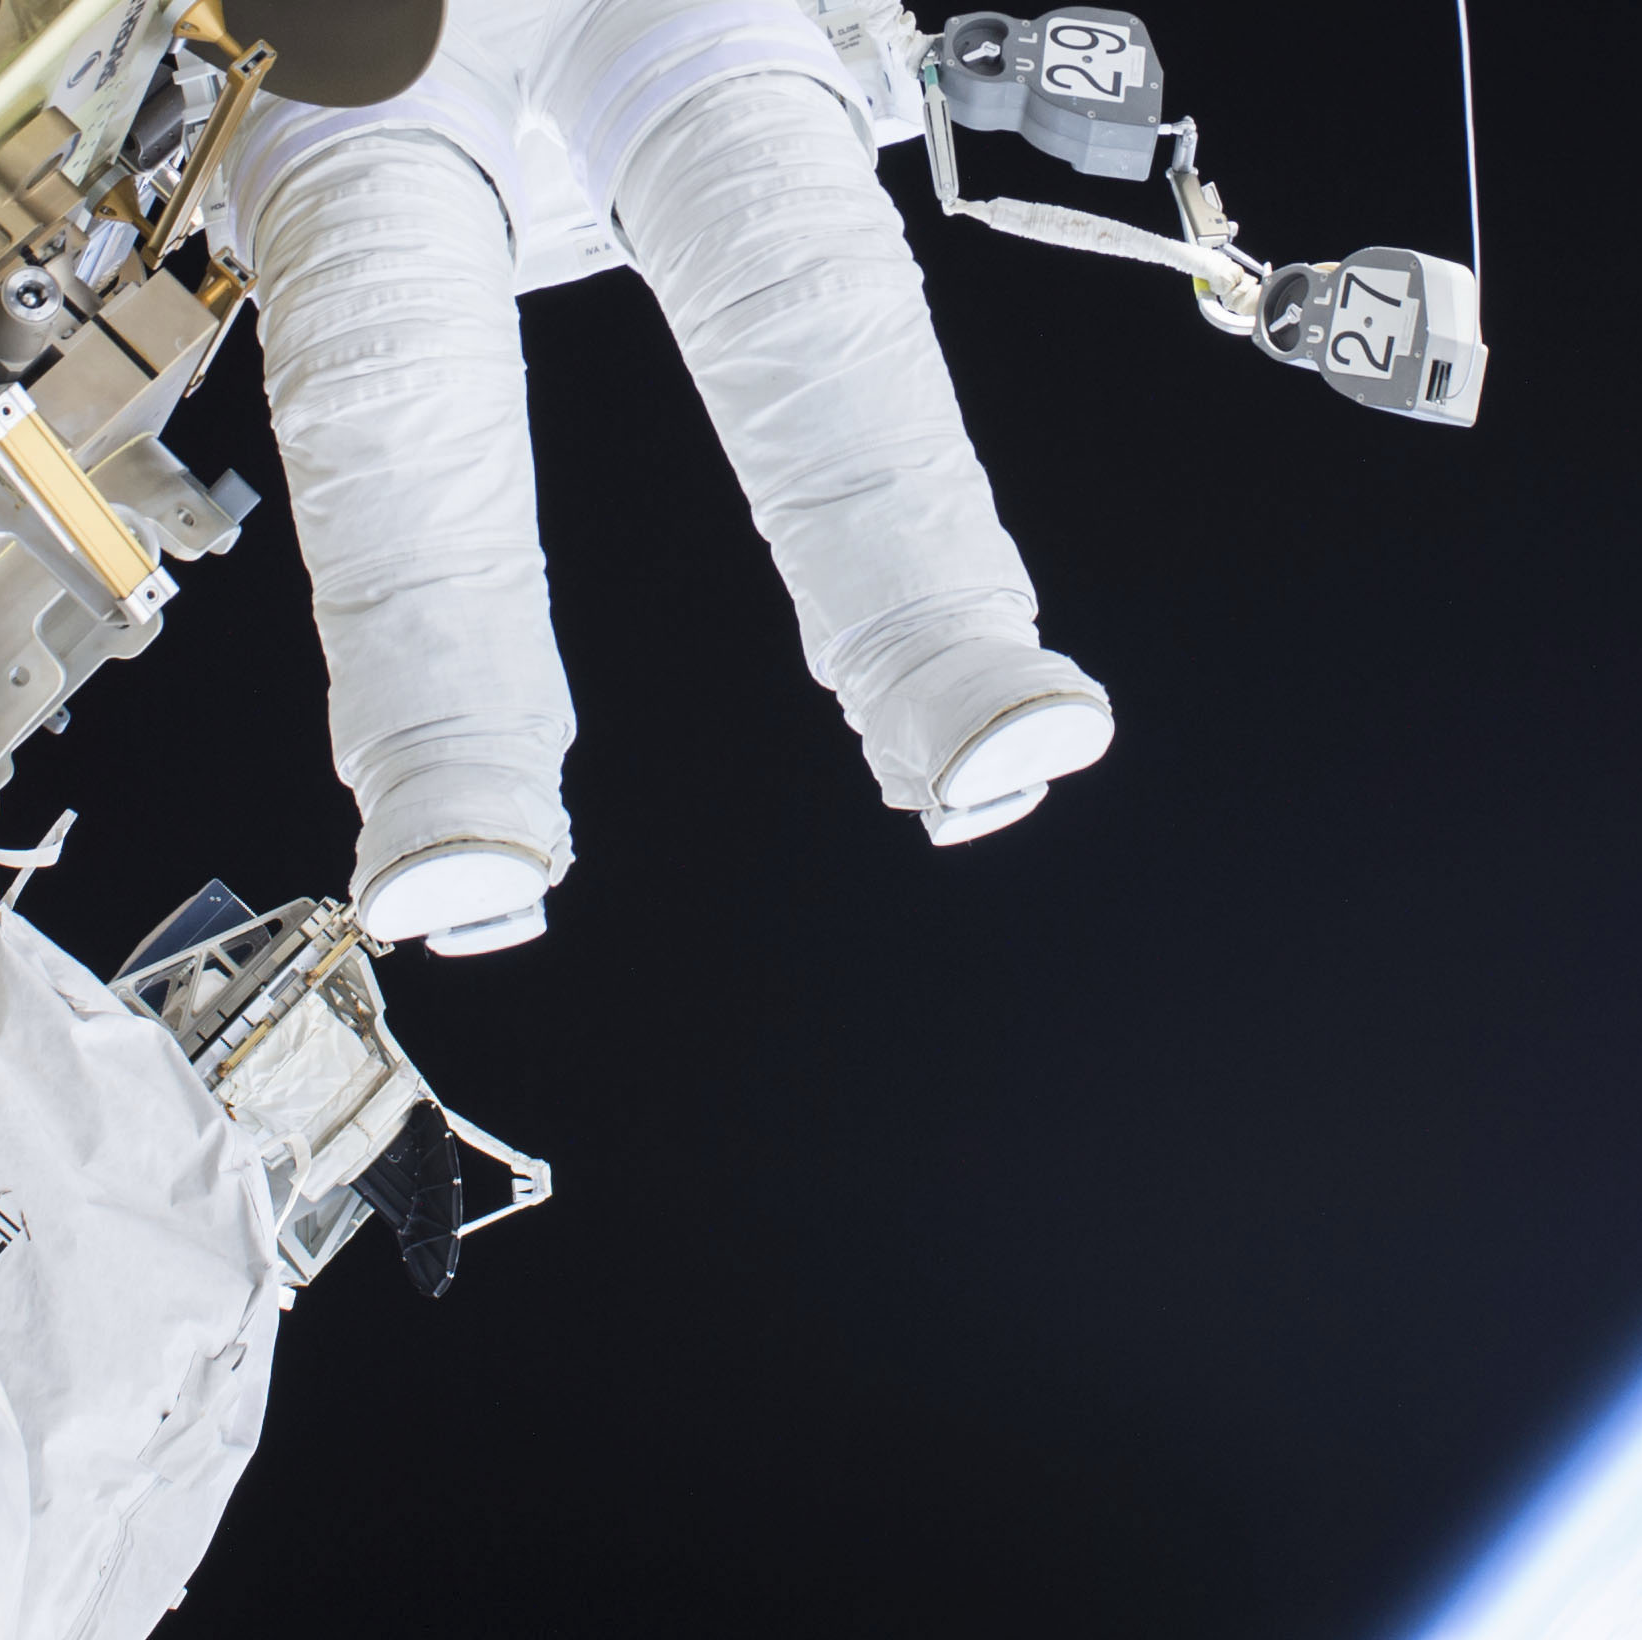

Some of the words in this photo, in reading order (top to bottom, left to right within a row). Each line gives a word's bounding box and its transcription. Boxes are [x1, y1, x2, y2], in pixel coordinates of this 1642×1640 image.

[1018, 32, 1038, 43] L
[1015, 57, 1035, 72] U
[1045, 25, 1126, 97] 29
[1313, 287, 1333, 306] L
[1331, 272, 1401, 372] 27
[1306, 324, 1325, 344] U
